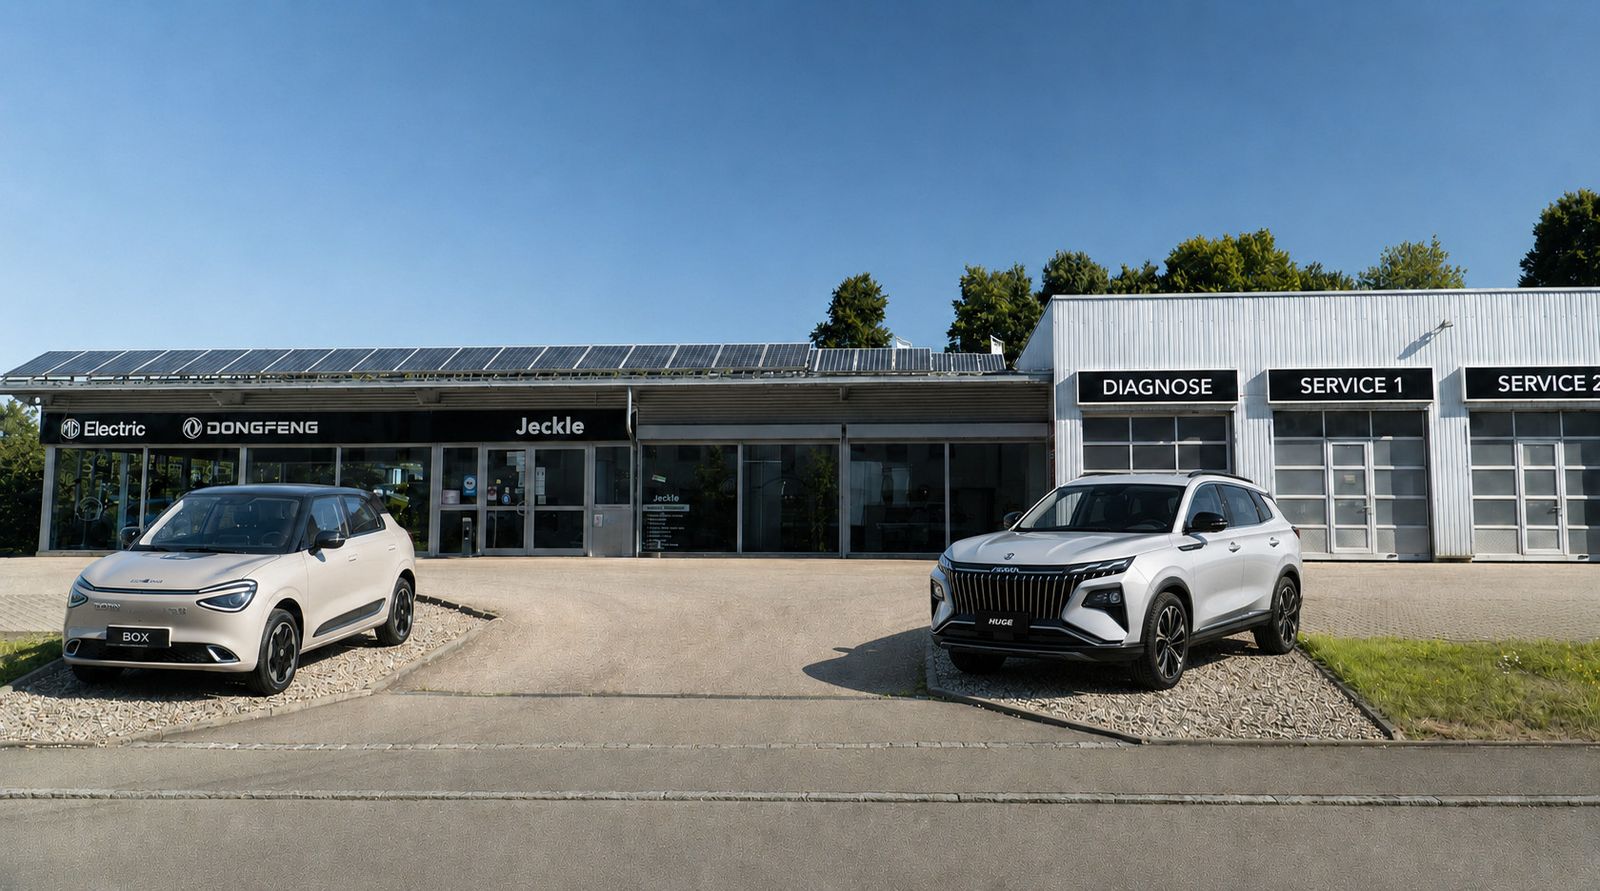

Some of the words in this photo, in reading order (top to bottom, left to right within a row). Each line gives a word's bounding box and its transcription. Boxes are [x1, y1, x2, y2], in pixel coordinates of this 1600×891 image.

[1103, 378, 1213, 396] DIAGNOSE
[1300, 376, 1386, 394] SERVICE
[1394, 376, 1402, 393] 1
[1498, 375, 1587, 392] SERVICE
[62, 420, 79, 437] MG
[84, 420, 146, 437] Electric
[206, 421, 319, 435] DONGFENG
[515, 416, 585, 435] Jeckle
[653, 494, 680, 503] Jeckle
[988, 618, 1014, 626] HUGE
[122, 632, 150, 643] BOX
